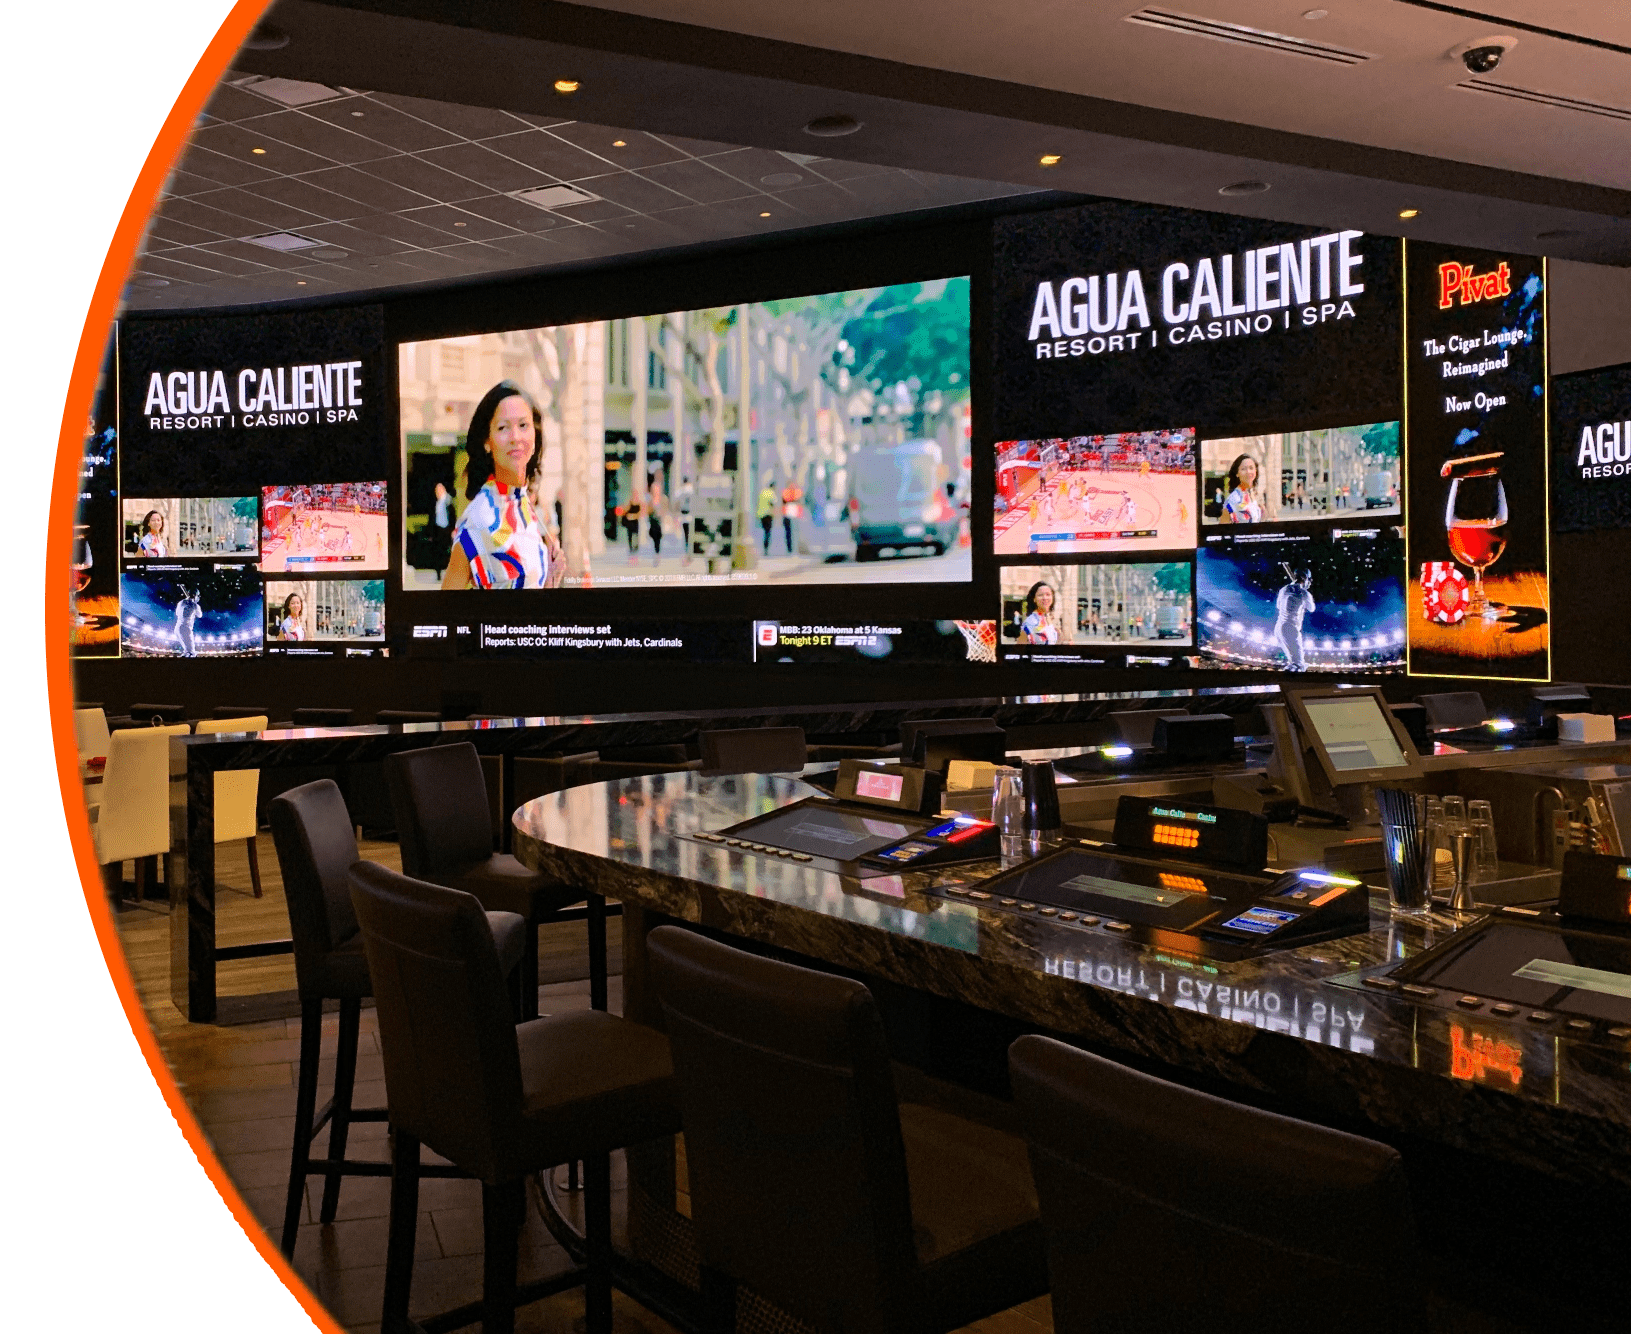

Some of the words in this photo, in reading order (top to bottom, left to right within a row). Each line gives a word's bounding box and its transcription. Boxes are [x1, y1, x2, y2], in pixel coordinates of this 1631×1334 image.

[1028, 269, 1151, 341] AGUA
[1162, 229, 1365, 324] CALIENTE
[1036, 332, 1142, 360] RESORT
[1168, 314, 1272, 345] CASINO
[1302, 300, 1357, 326] SPA
[1423, 338, 1446, 357] The
[1448, 335, 1481, 355] Cigar
[1483, 329, 1528, 346] Lounge.
[1442, 350, 1509, 378] Reimagined
[144, 370, 230, 415] AGUA
[238, 360, 363, 411] CALIENTE
[1445, 396, 1472, 413] Now
[1474, 391, 1507, 412] Open
[150, 415, 225, 430] RESORT
[242, 411, 310, 428] CASINO
[326, 408, 359, 424] SPA
[1577, 420, 1631, 467] AGU
[1582, 462, 1631, 479] RESOR
[412, 625, 448, 638] ESPN
[456, 625, 472, 635] NFL
[484, 624, 506, 635] Head
[507, 624, 548, 637] coaching
[548, 624, 596, 635] interviews
[596, 624, 612, 635] set
[779, 625, 801, 635] MBB:
[801, 625, 813, 635] 23
[813, 625, 854, 635] Oklahoma
[854, 626, 864, 635] at
[864, 626, 871, 635] 5
[871, 625, 903, 635] Kansas
[484, 636, 517, 649] Reports:
[517, 637, 534, 647] USC
[534, 637, 548, 647] OC
[548, 637, 565, 647] Kliff
[564, 637, 604, 650] Kingsbury
[604, 637, 622, 647] with
[622, 637, 643, 648] Jets,
[643, 637, 683, 648] Cardinals
[779, 635, 812, 648] Tonight
[812, 636, 820, 646] 9
[820, 636, 833, 646] ET
